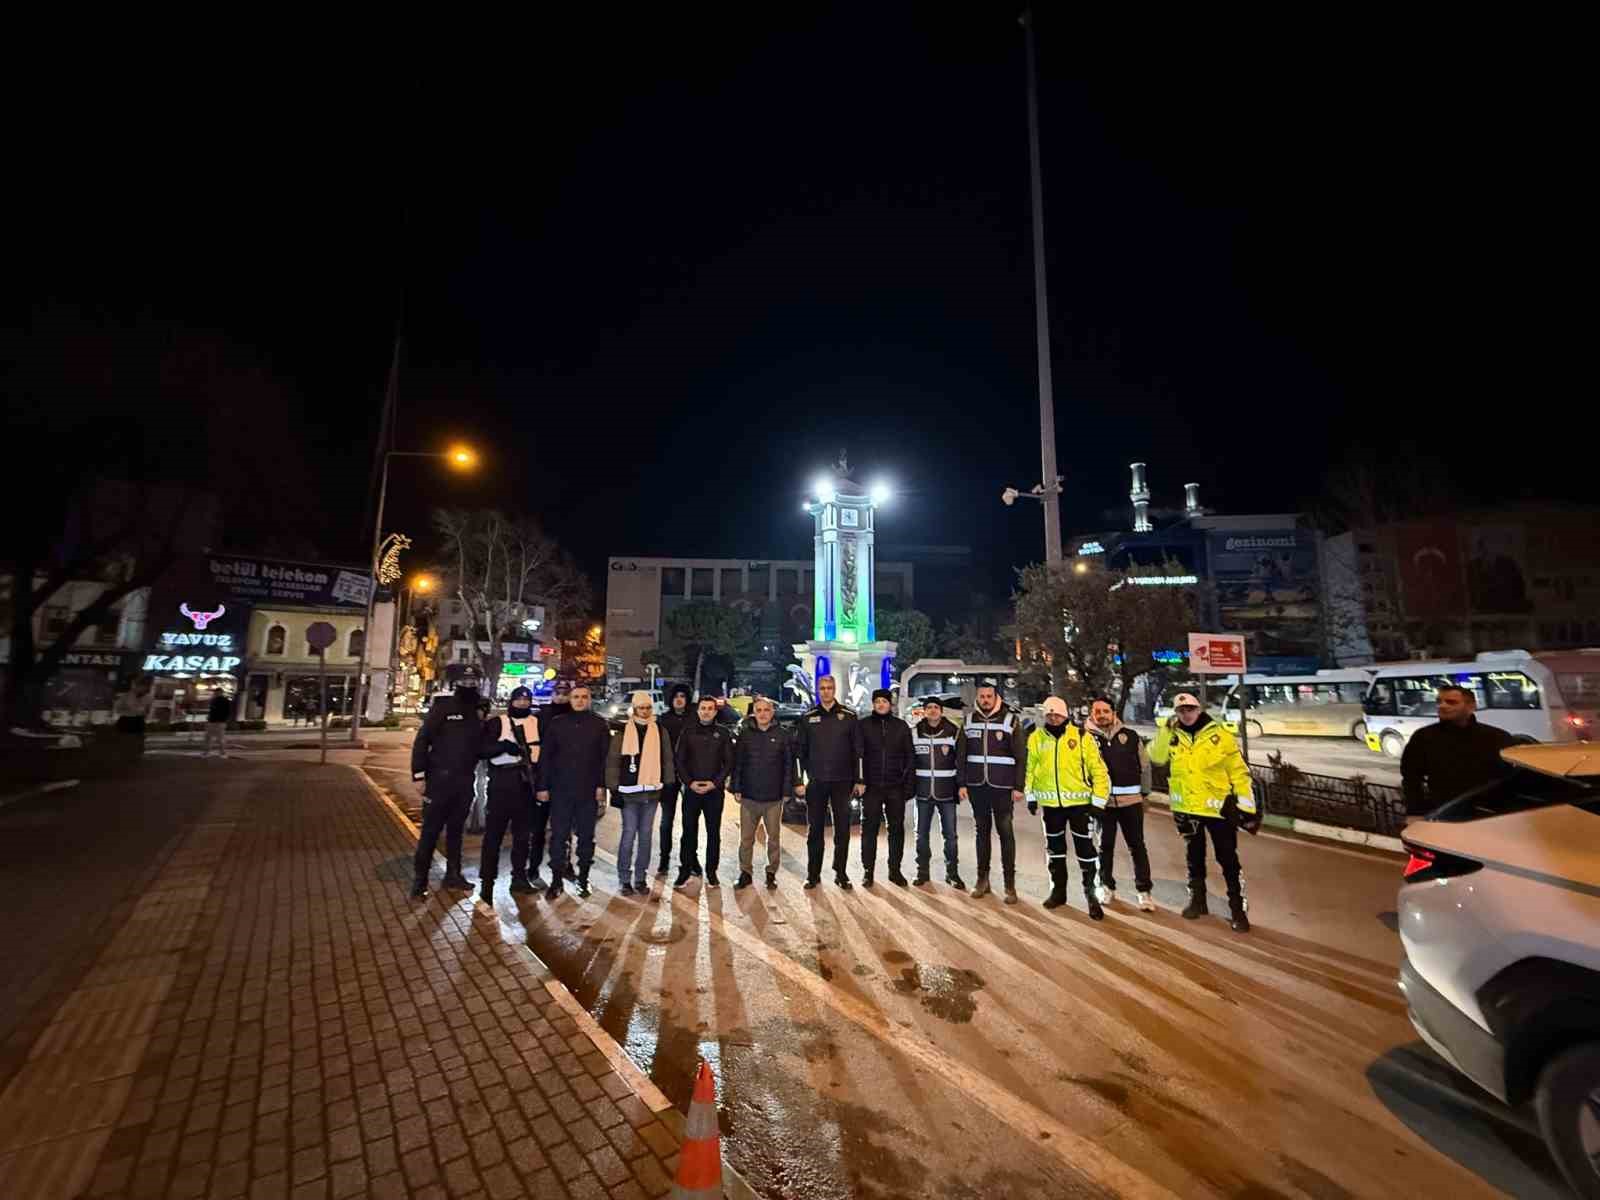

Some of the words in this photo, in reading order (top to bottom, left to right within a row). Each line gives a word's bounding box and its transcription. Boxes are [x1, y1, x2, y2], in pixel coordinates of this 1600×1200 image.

[260, 564, 329, 584] telekom
[161, 633, 232, 646] YAVUZ
[142, 655, 241, 671] KASAP
